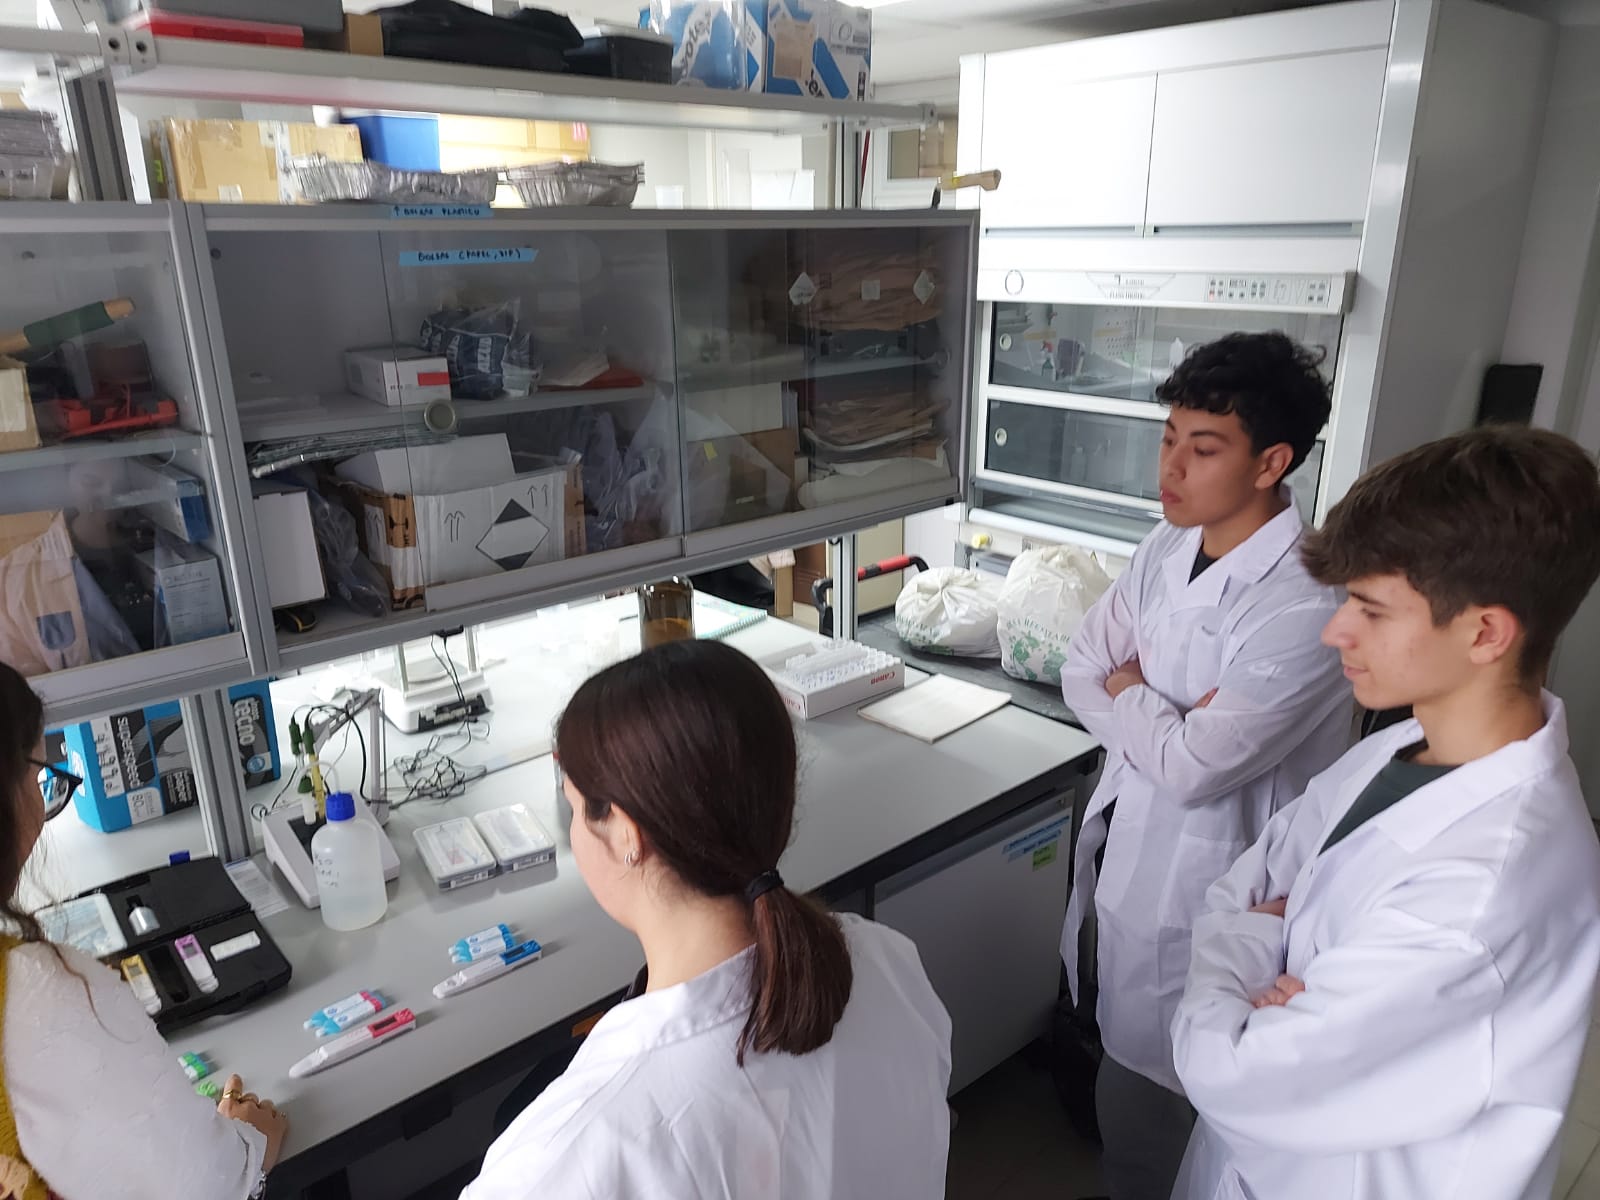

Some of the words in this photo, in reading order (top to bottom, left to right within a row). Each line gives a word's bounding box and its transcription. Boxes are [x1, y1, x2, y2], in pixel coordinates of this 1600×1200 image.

[870, 671, 896, 685] Canon
[233, 698, 256, 746] tecno
[117, 716, 141, 788] superspeed
